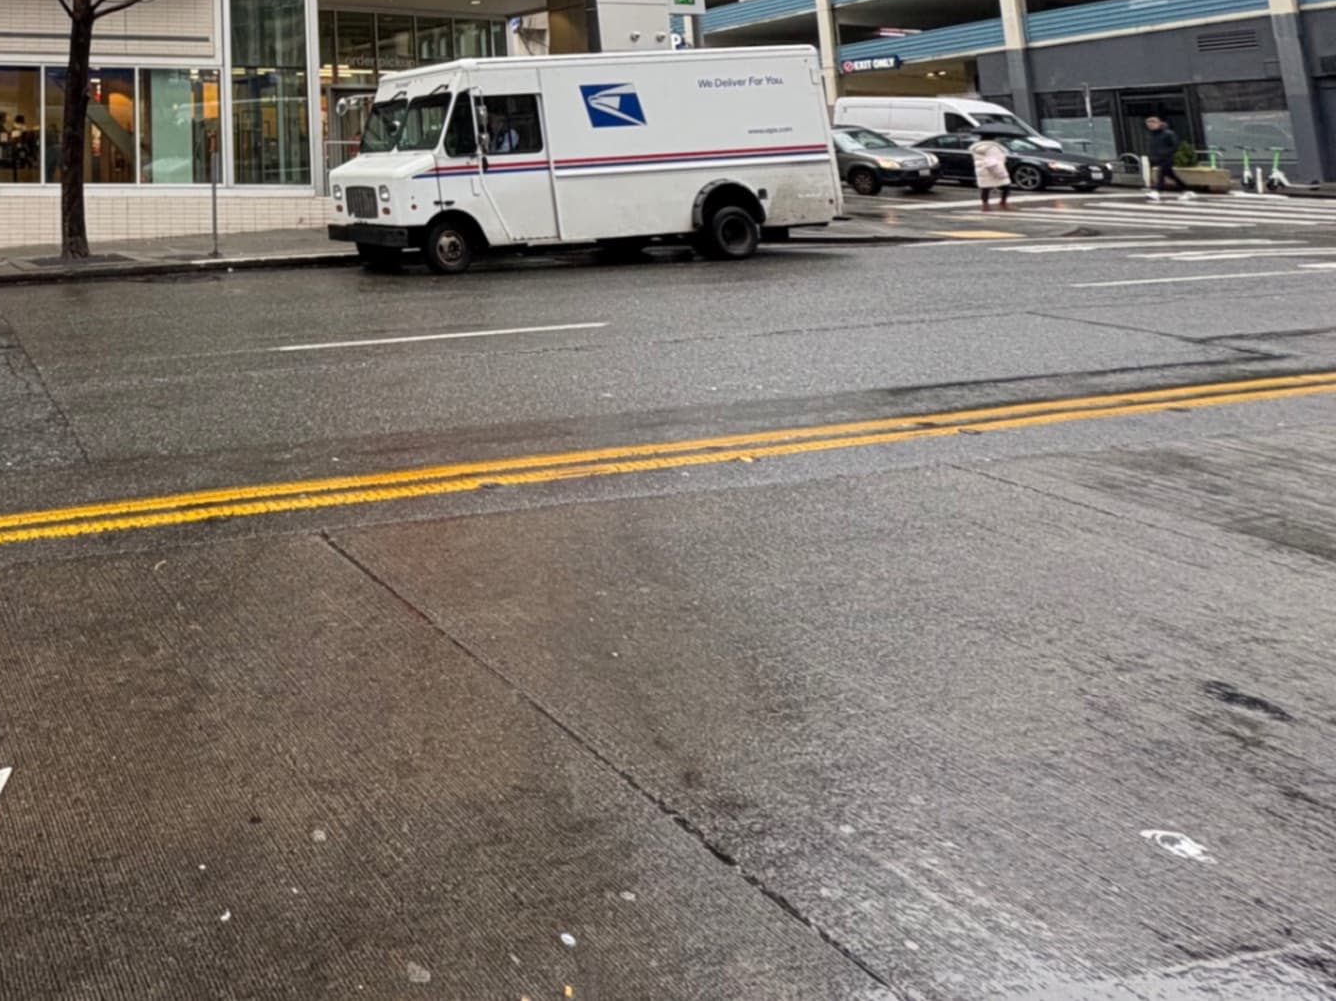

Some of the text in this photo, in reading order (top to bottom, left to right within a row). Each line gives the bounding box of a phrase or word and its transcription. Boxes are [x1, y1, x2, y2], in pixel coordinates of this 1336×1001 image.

[854, 58, 895, 70] EXIT ONLY
[697, 79, 712, 89] We
[714, 78, 746, 88] Deliver
[748, 76, 763, 86] For
